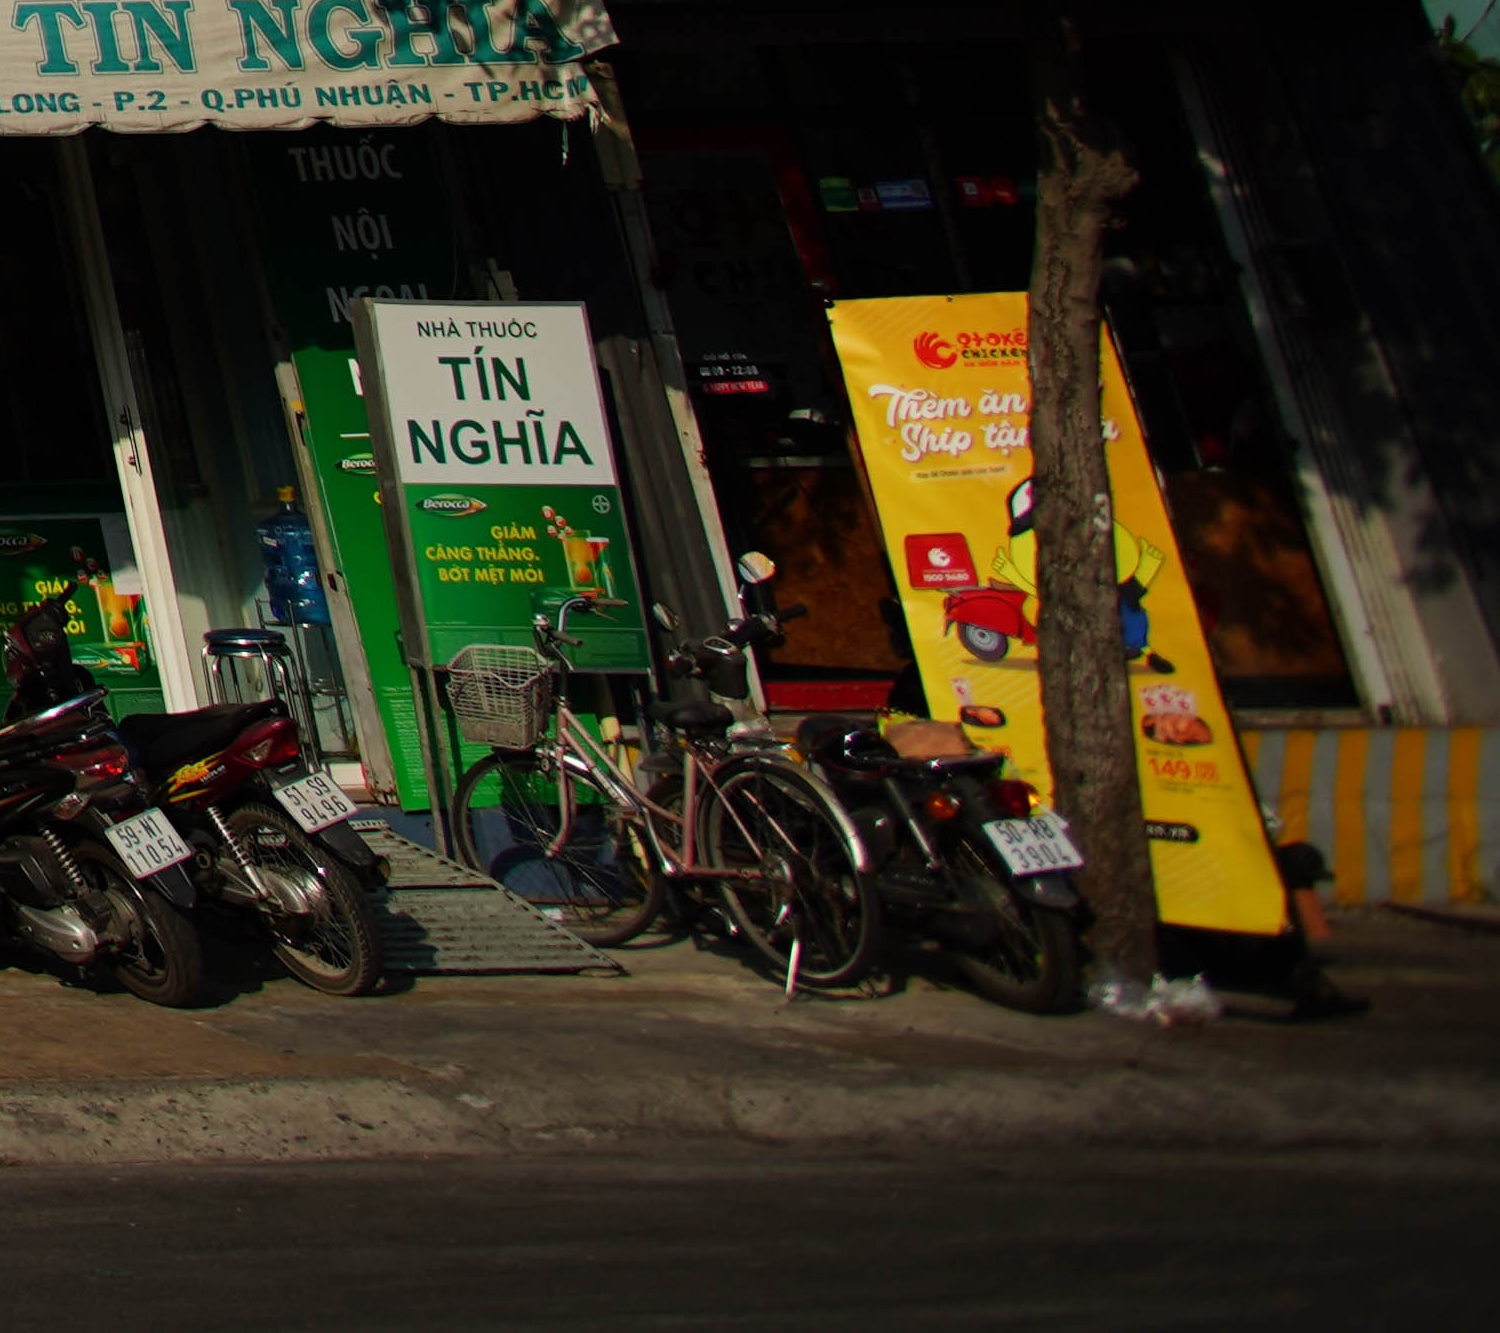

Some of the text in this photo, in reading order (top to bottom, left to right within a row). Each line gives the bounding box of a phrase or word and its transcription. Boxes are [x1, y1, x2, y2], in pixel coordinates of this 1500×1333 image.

[112, 88, 168, 113] P.2
[199, 79, 303, 112] Q.PHÚ
[315, 79, 433, 112] NHUẬN
[463, 77, 590, 104] TP.HCM
[286, 141, 403, 184] THUỐC
[331, 211, 394, 262] NỘI
[416, 316, 462, 339] NHÀ
[438, 345, 532, 402] TÍN
[868, 383, 1028, 429] Thèm ăn
[406, 409, 595, 466] NGHĨA
[900, 422, 974, 463] Ship
[421, 497, 471, 511] Berocca
[490, 518, 537, 541] GIẢM
[425, 545, 472, 563] CĂNG
[437, 561, 545, 586] BỚT MỆT MỎI
[300, 795, 348, 827] 9496
[117, 814, 166, 848] 59-N1
[125, 836, 187, 876] 110.54
